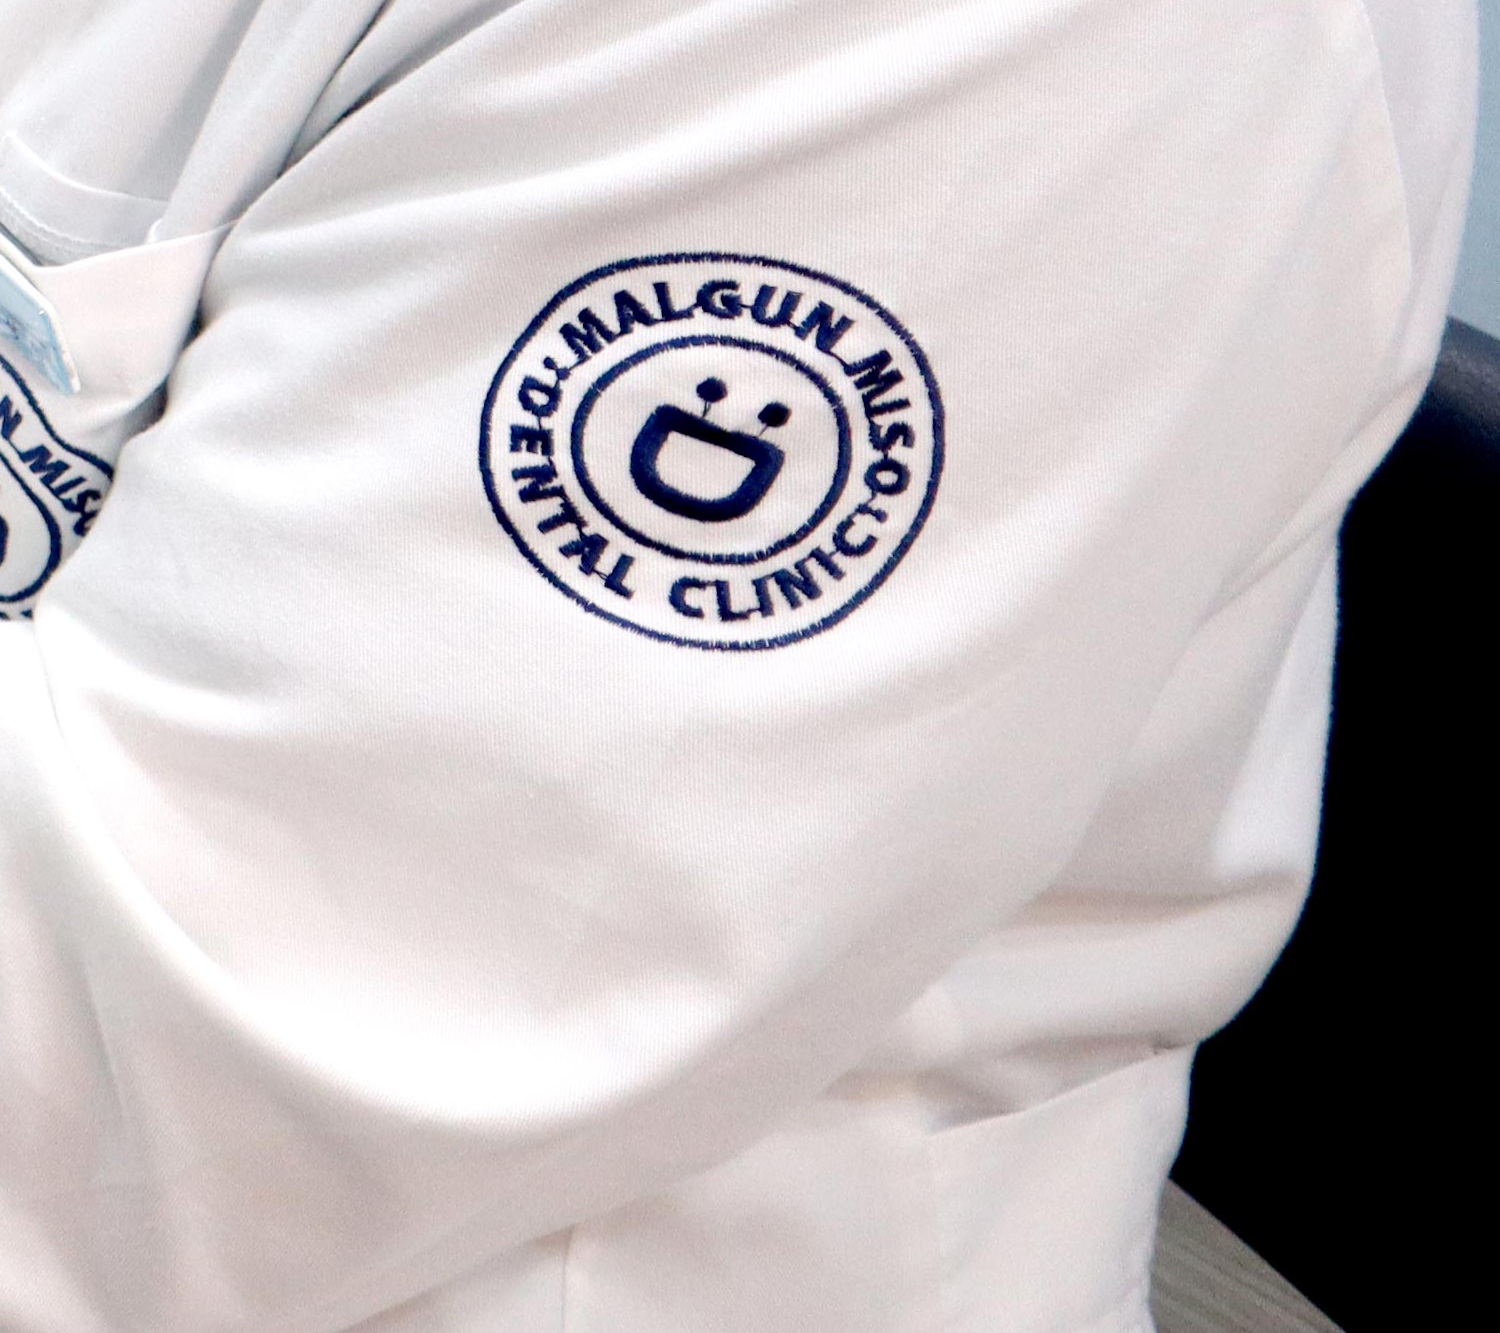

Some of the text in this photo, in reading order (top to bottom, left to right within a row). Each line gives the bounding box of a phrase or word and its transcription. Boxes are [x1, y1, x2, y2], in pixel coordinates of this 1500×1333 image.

[510, 375, 878, 622] DENTAL CLINIC
[559, 279, 917, 496] MALGUN MISO
